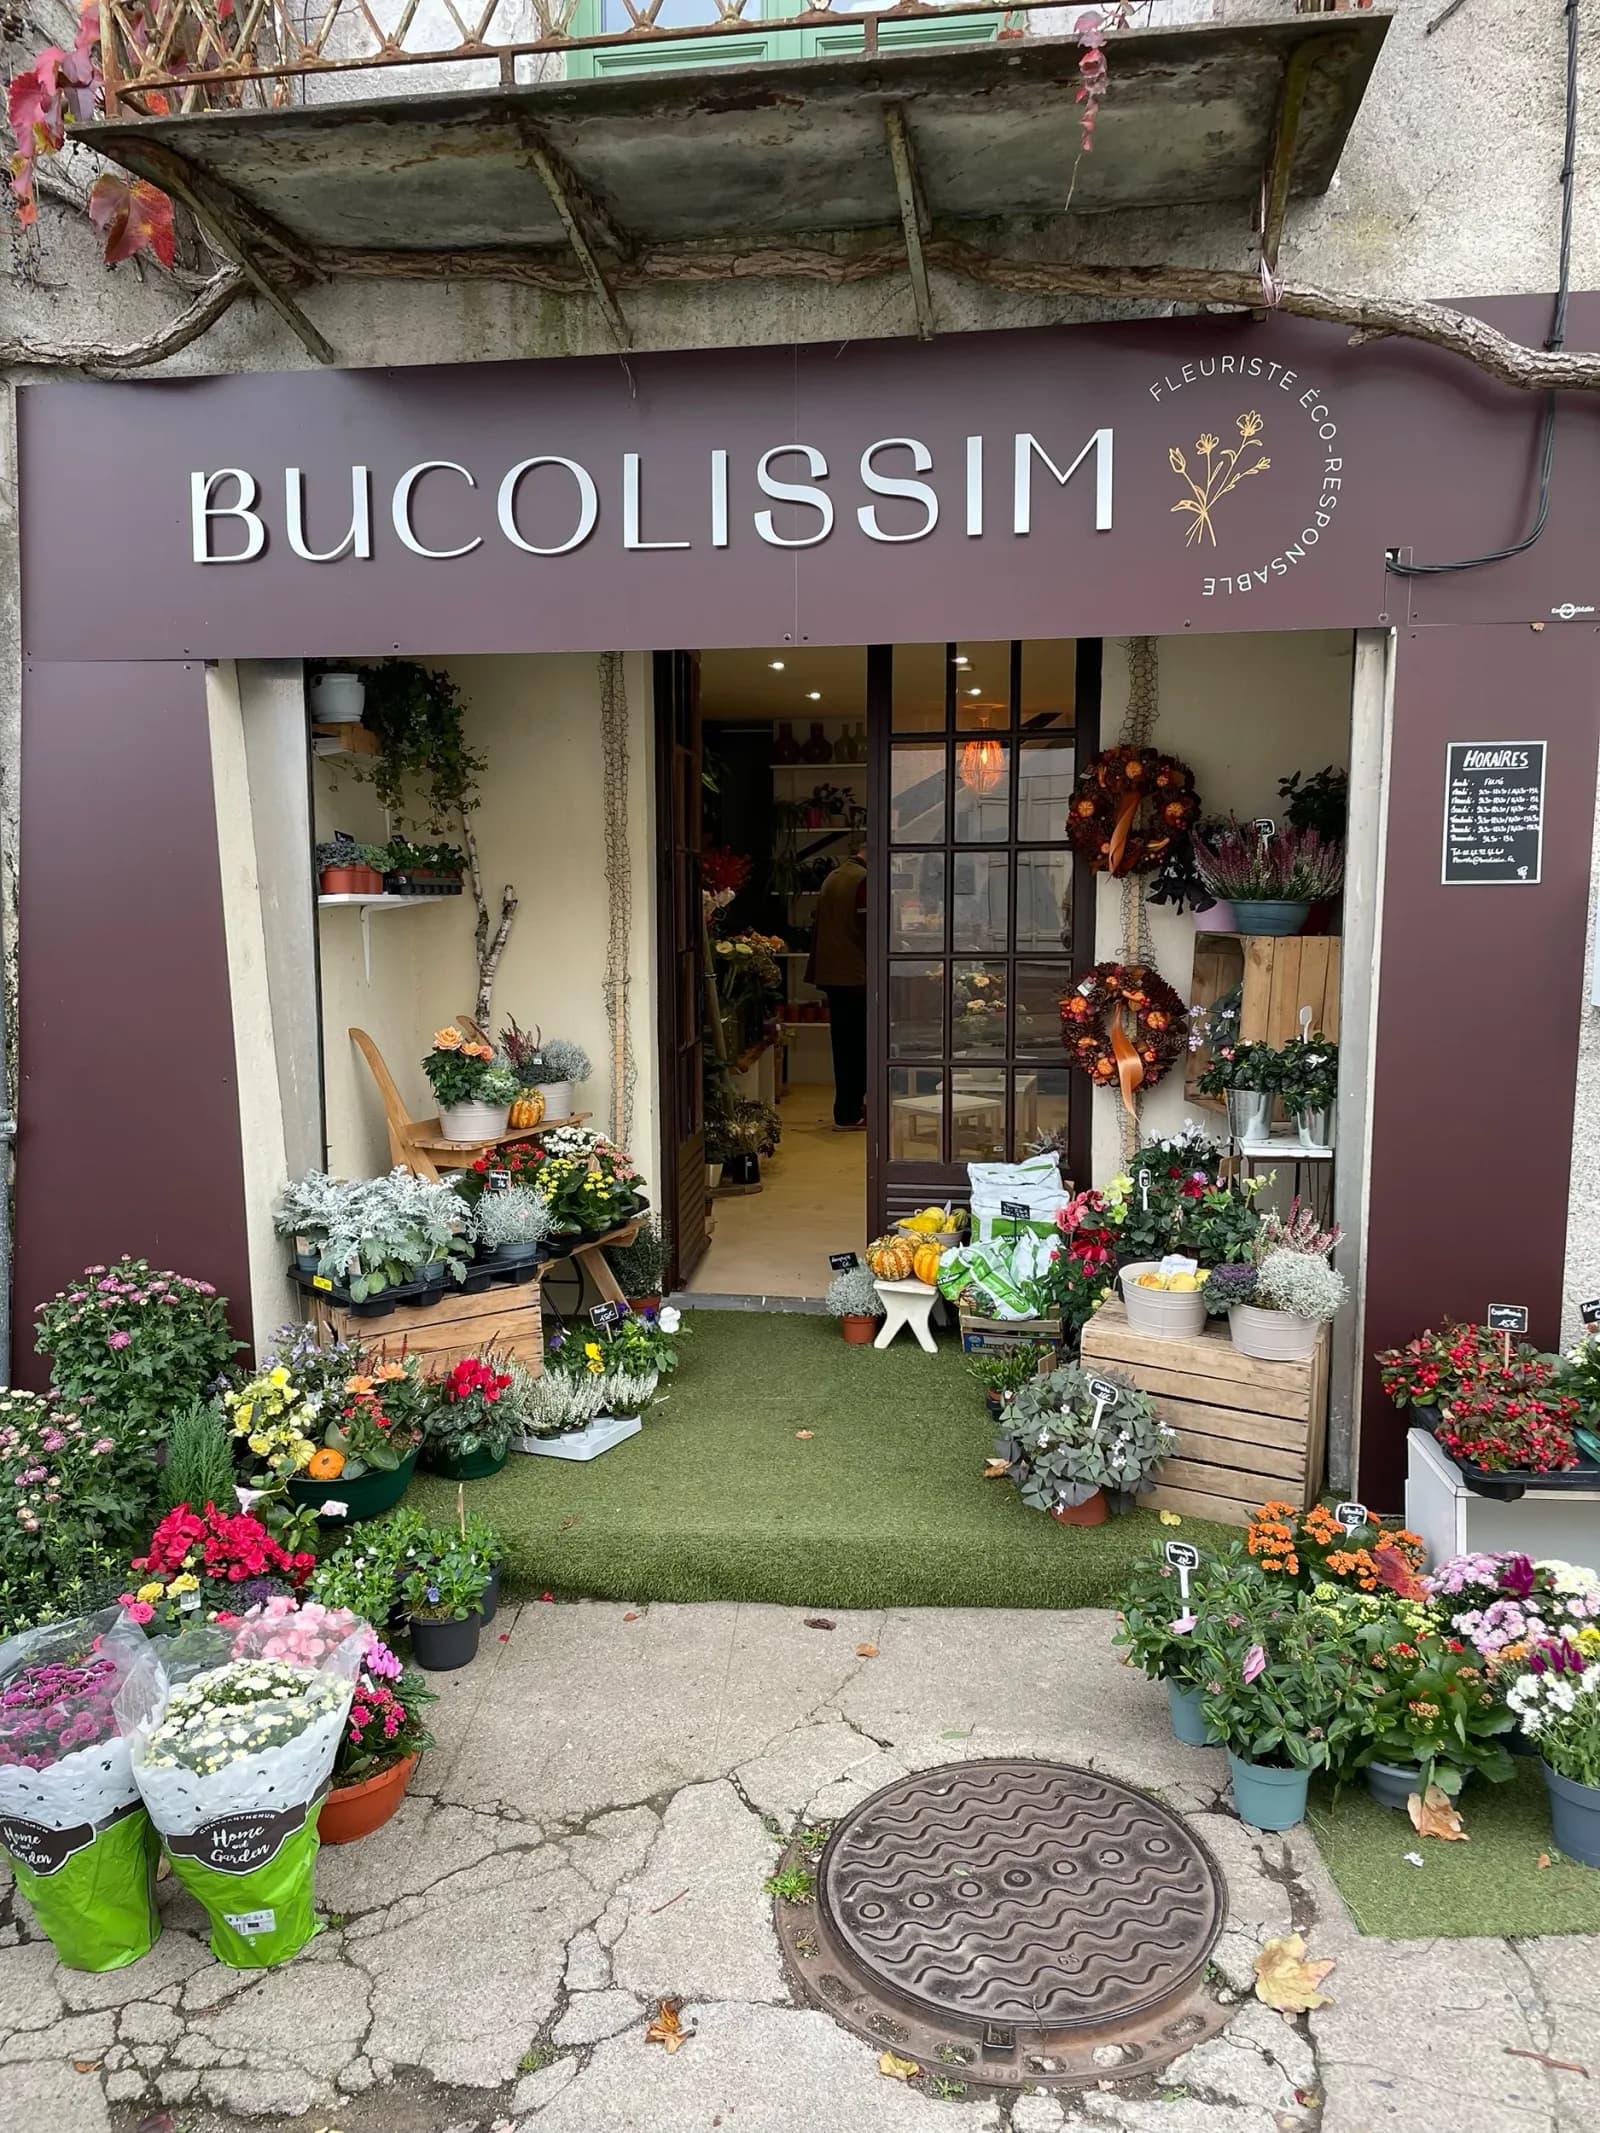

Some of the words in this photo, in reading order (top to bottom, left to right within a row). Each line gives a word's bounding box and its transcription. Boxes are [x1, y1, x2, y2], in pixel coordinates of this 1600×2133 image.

[1149, 355, 1298, 402] FLEURISTE
[190, 428, 1114, 563] BUCOLISSIM
[1201, 388, 1343, 596] ÉCO-RESPONSABLE
[1462, 750, 1529, 768] HORAIRES
[211, 1823, 264, 1848] Home
[210, 1844, 270, 1864] Garden
